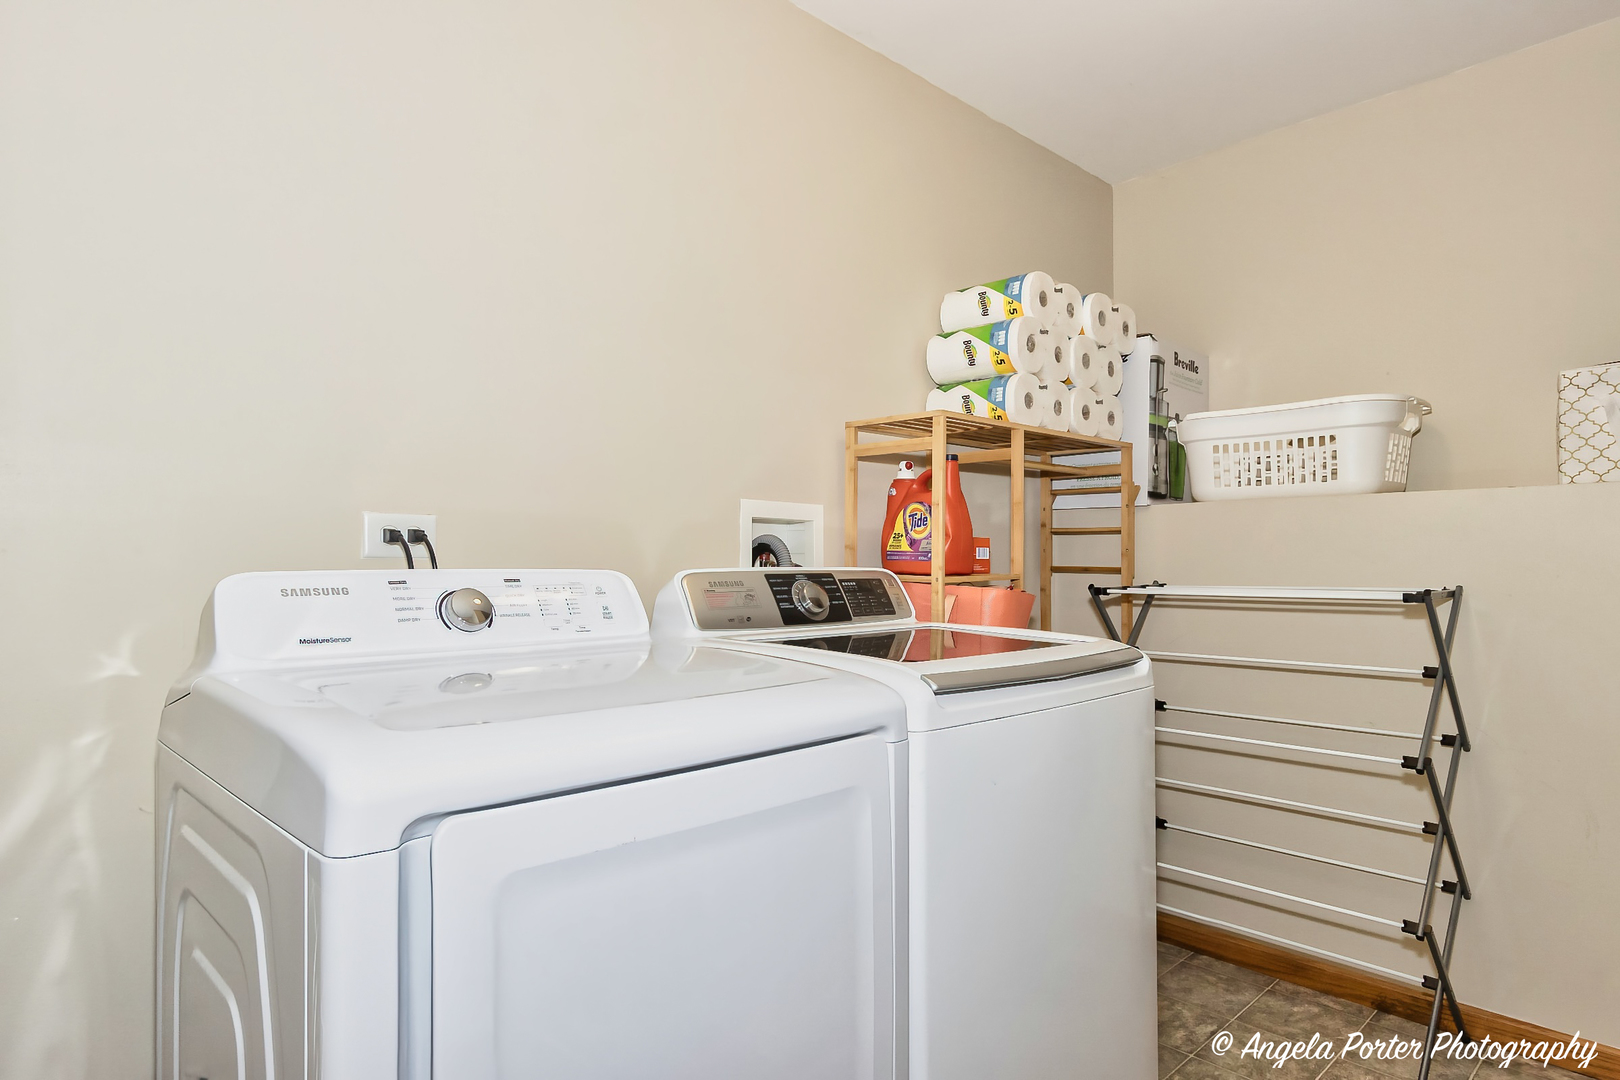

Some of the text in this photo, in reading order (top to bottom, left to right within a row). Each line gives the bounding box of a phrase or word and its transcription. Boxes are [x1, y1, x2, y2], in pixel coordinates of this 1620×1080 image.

[978, 291, 989, 317] Bounty
[963, 340, 976, 367] Bounty
[1174, 351, 1199, 374] Breville
[962, 394, 973, 415] Boun
[908, 512, 928, 532] Tide
[280, 587, 350, 597] SAMSUNG
[708, 580, 744, 588] SAMSUNG
[299, 637, 351, 645] MoistureSensor
